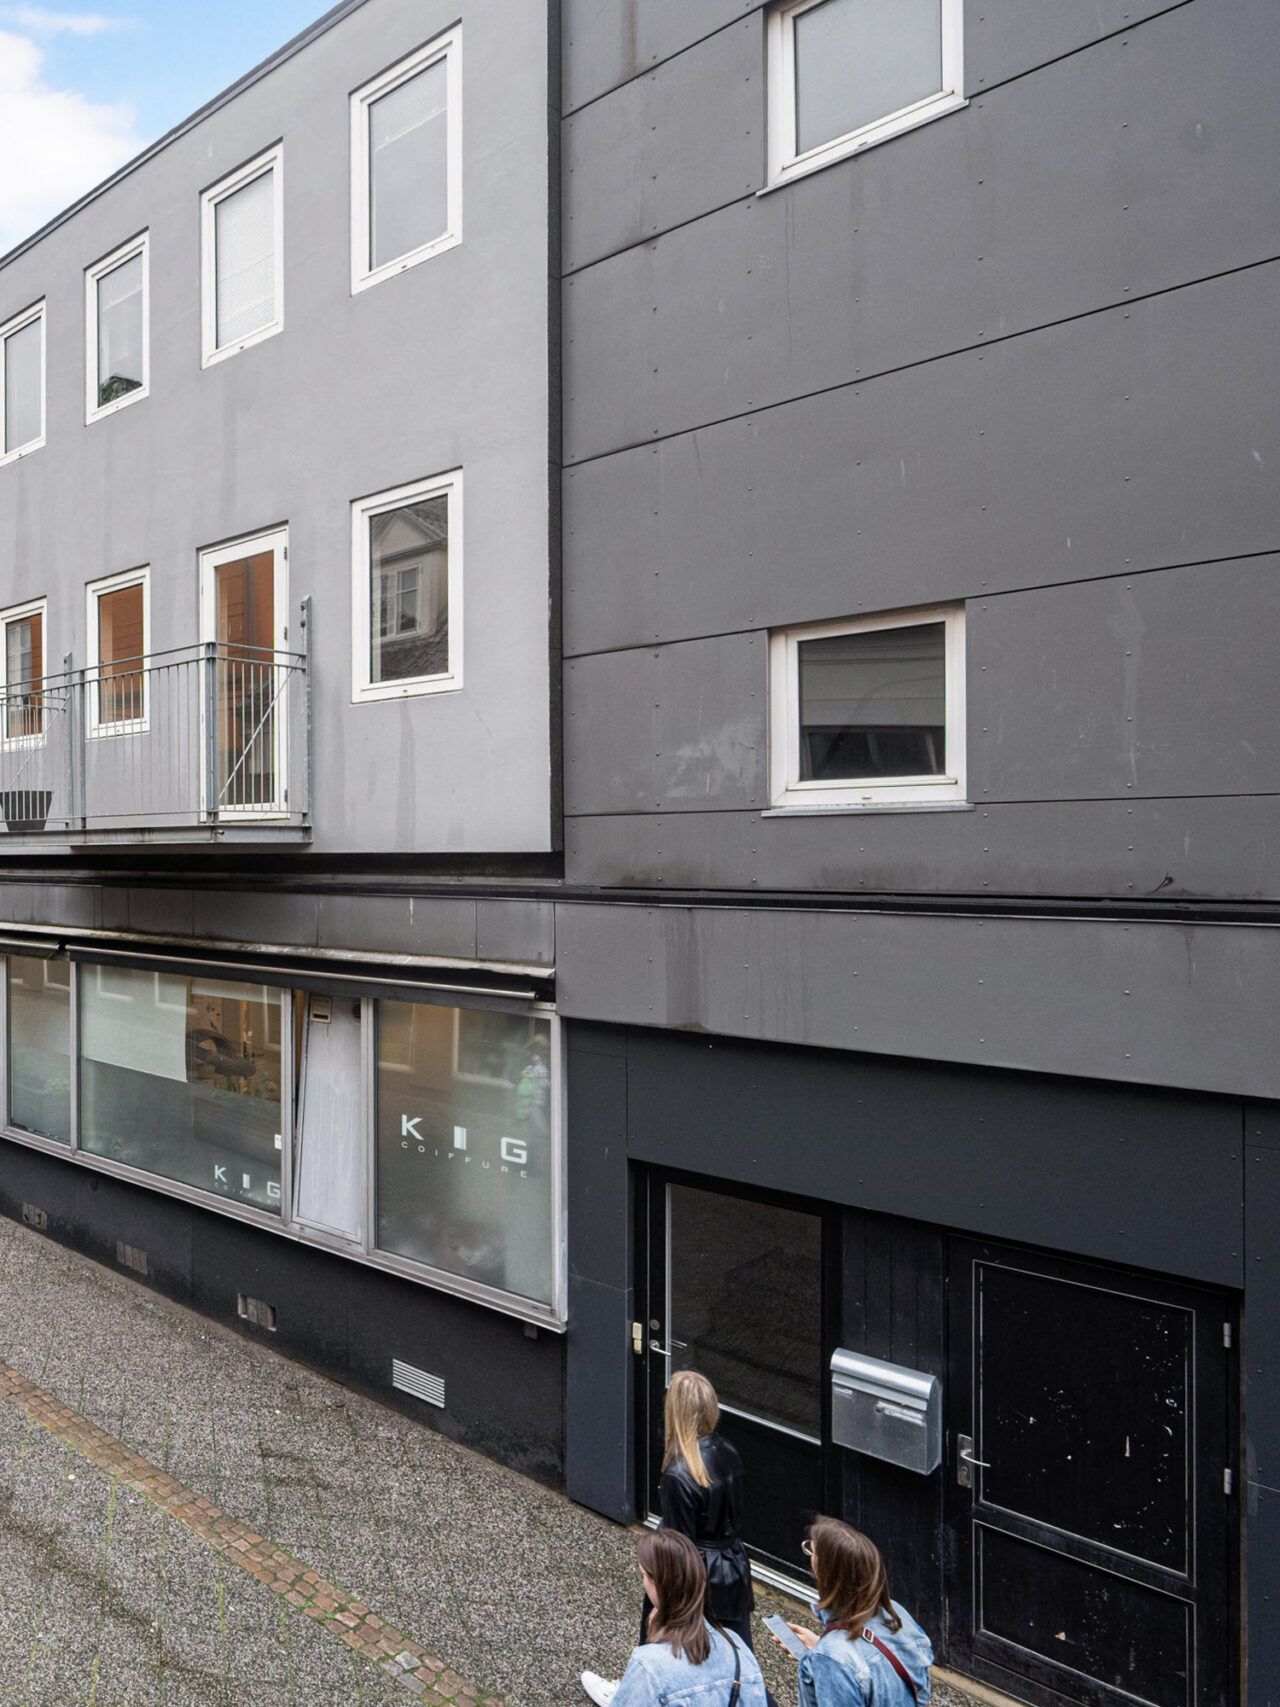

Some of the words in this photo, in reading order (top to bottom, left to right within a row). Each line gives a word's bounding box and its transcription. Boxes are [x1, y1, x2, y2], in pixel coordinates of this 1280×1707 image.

[401, 1114, 527, 1164] KIG
[401, 1141, 528, 1179] COIFFURE
[214, 1164, 281, 1199] KIG
